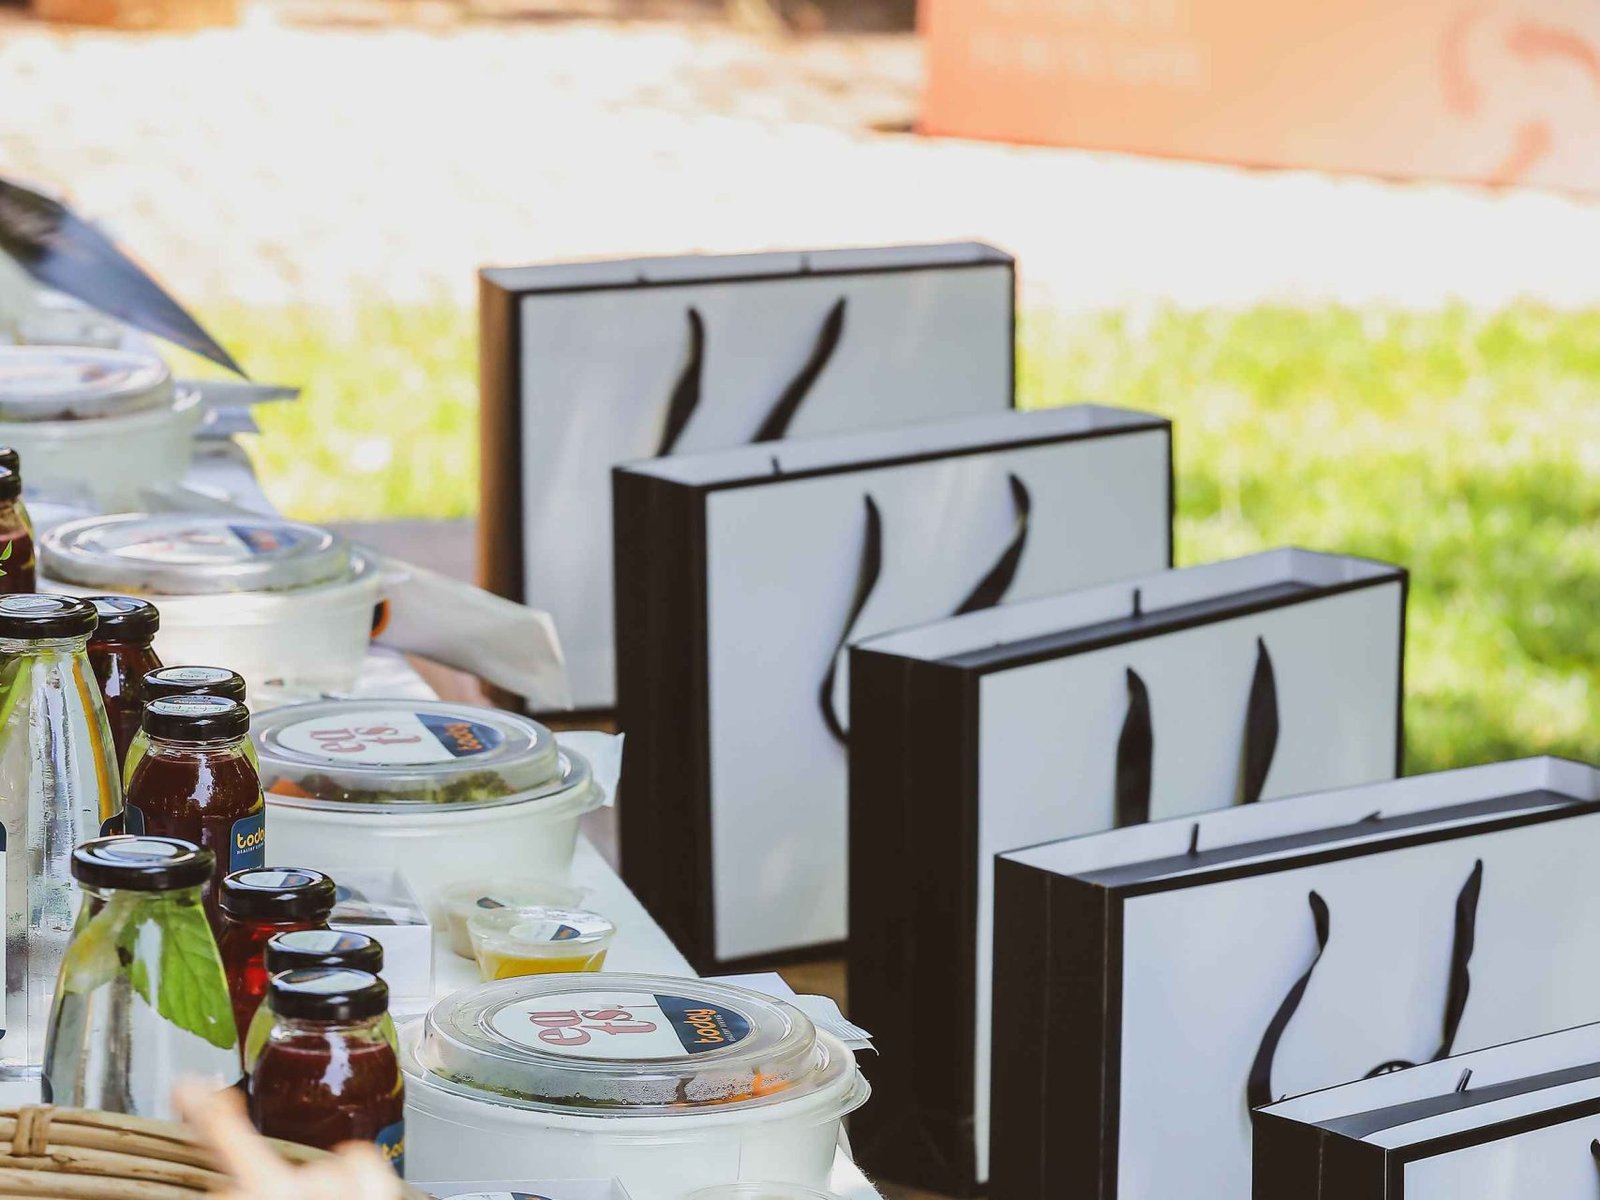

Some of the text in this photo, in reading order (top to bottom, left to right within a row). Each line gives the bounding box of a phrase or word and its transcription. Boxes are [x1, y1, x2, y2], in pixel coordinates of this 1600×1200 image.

[528, 1010, 591, 1046] ea
[581, 1009, 657, 1035] ts
[683, 1008, 724, 1044] today
